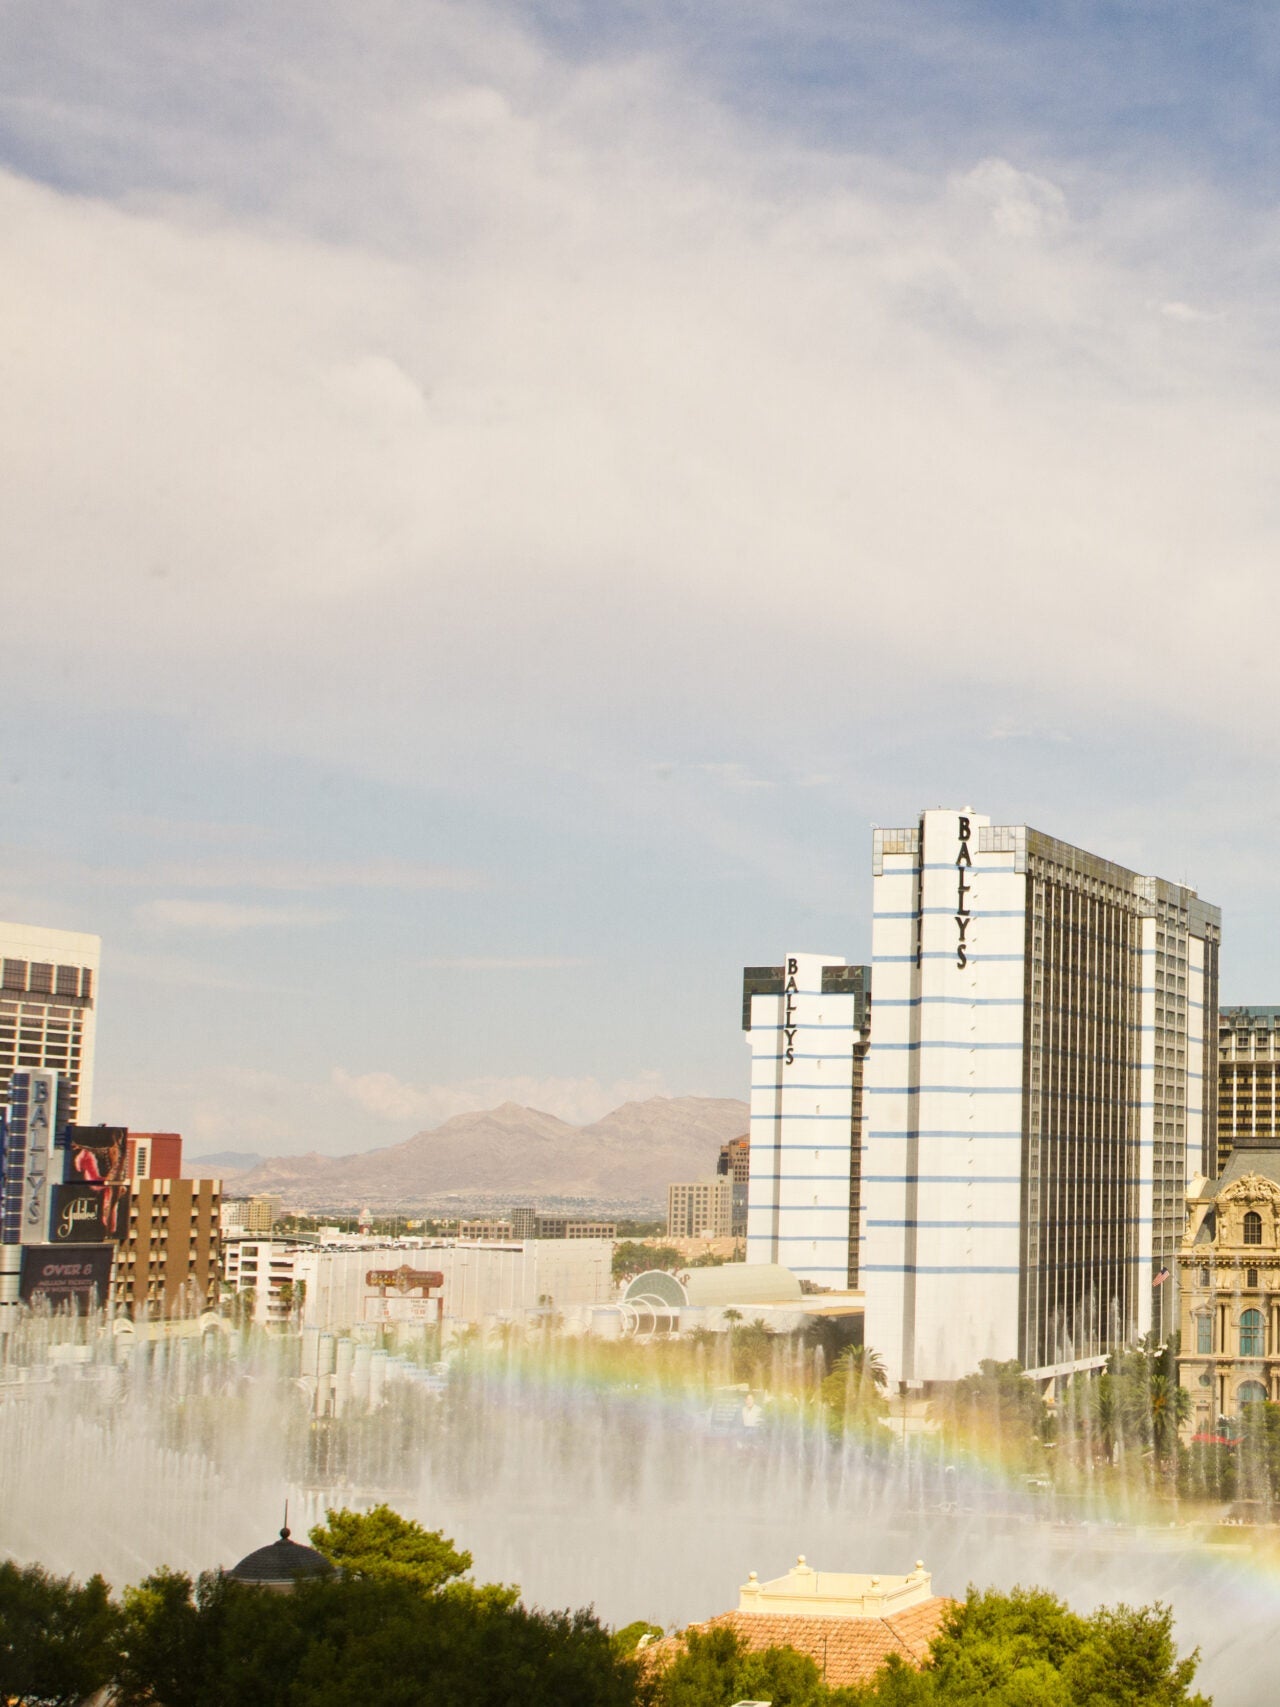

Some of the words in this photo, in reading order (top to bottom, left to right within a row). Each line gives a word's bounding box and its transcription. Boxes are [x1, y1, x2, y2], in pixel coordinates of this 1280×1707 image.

[954, 816, 972, 970] BALLYS
[784, 958, 799, 1066] BALLYS
[26, 1080, 49, 1226] BALLYS
[42, 1264, 81, 1276] OVER
